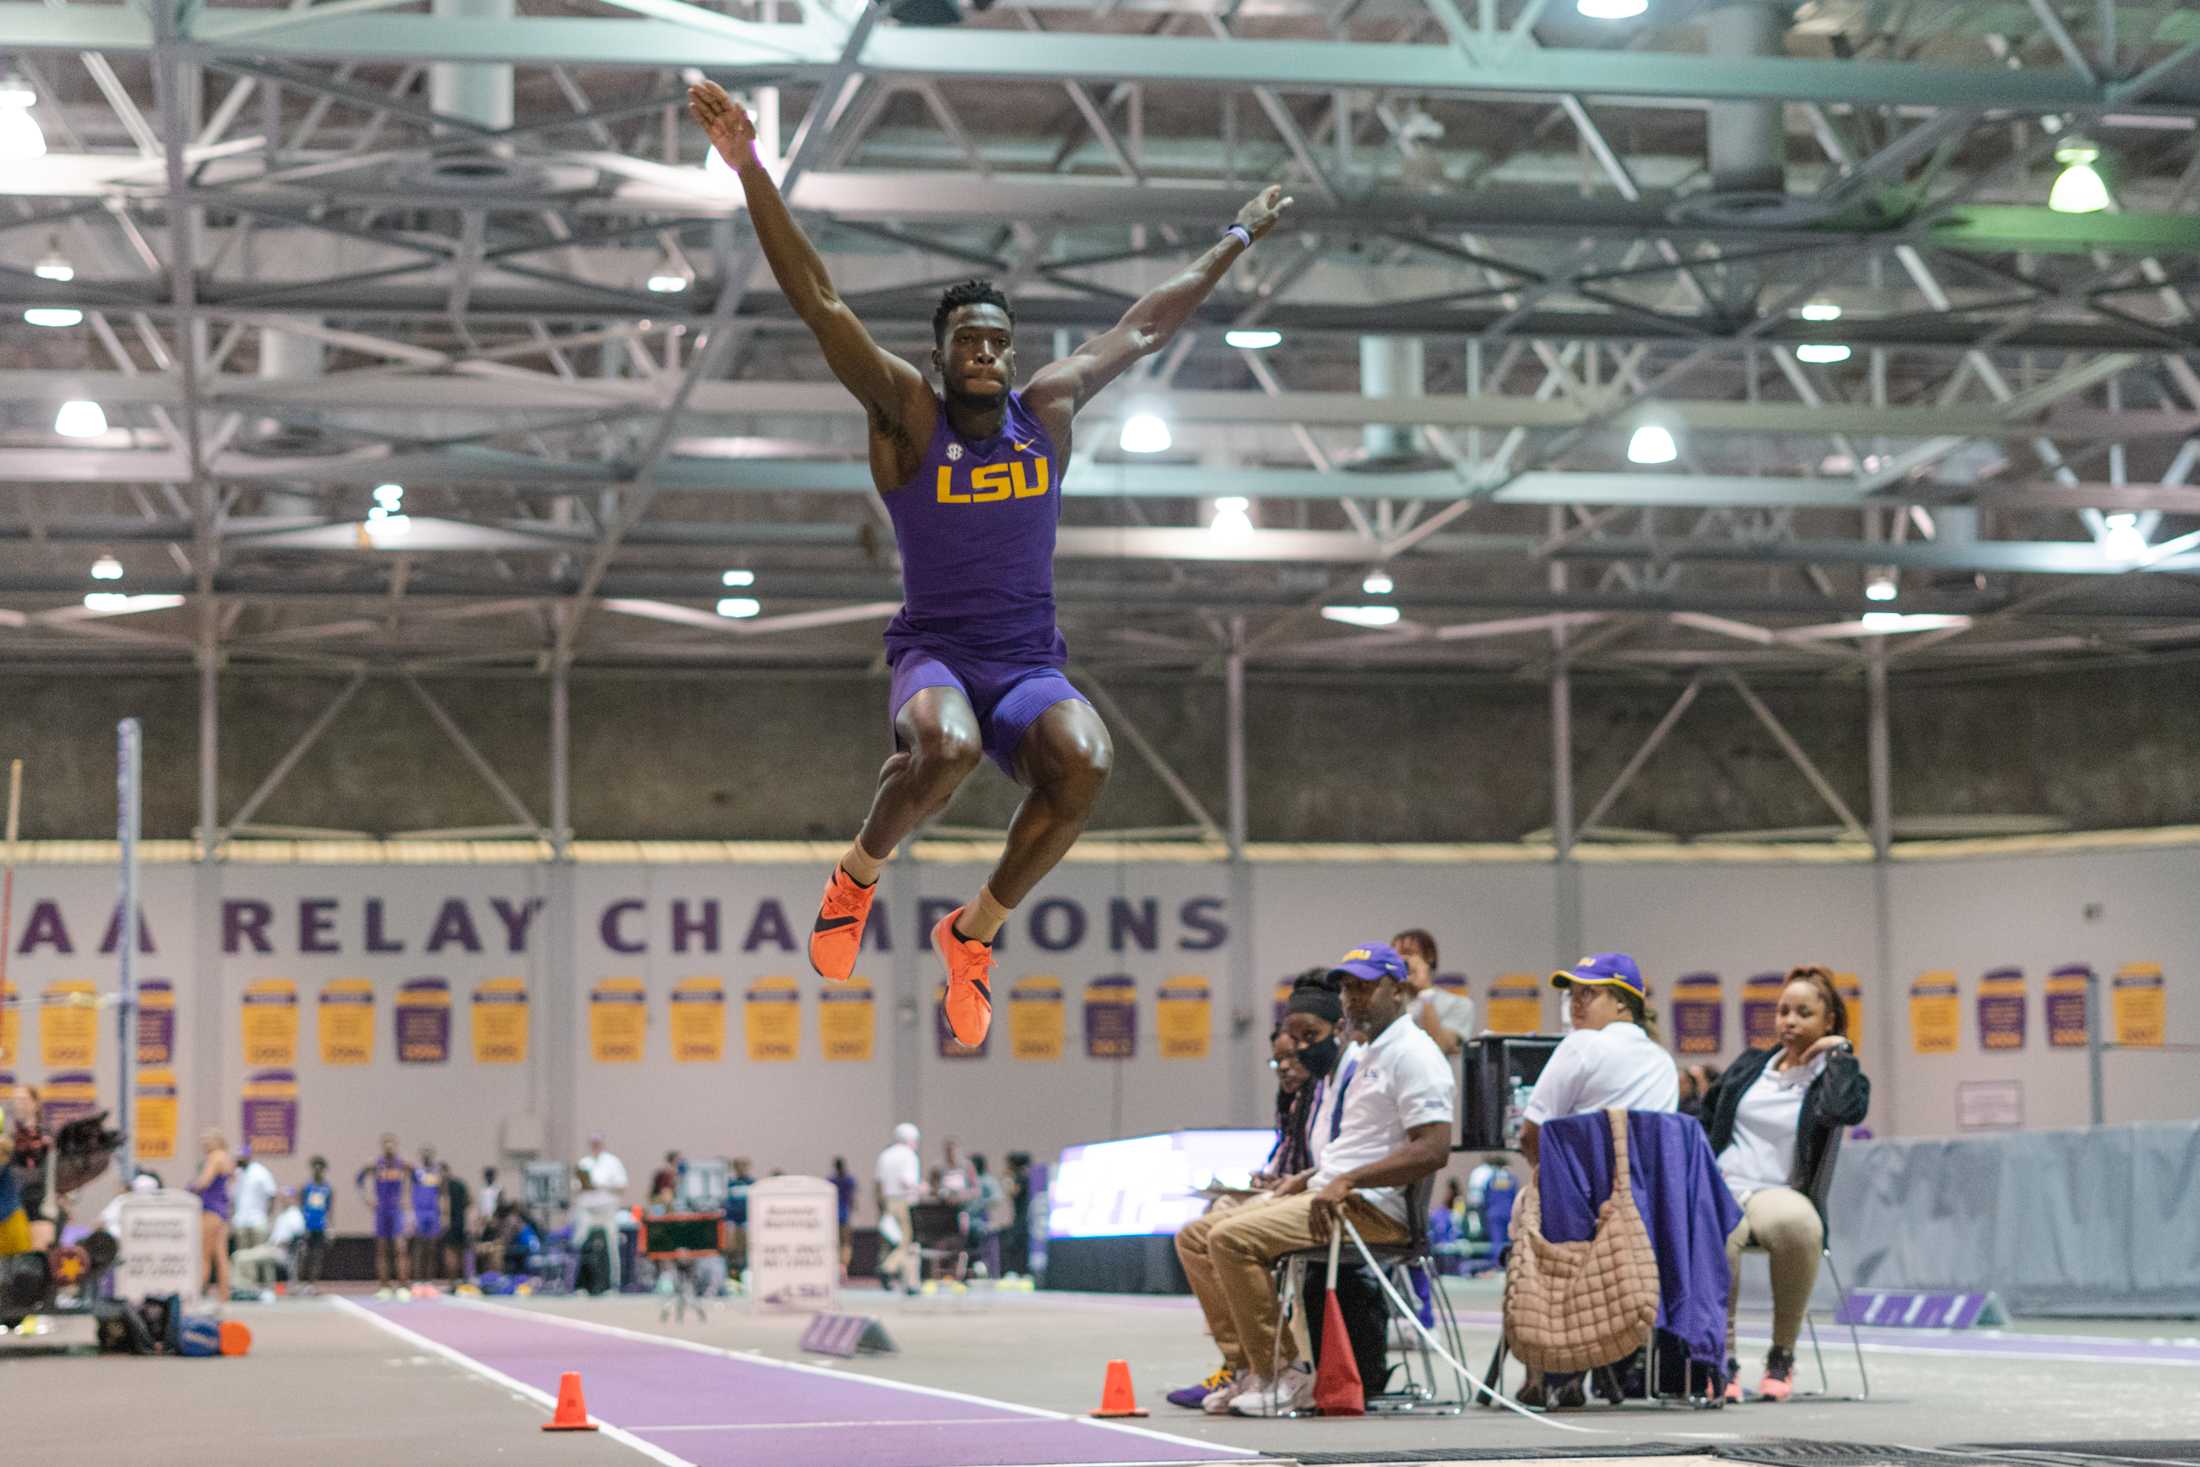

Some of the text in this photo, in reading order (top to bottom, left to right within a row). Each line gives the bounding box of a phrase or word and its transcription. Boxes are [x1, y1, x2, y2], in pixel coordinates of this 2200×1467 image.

[937, 456, 1049, 503] LSU
[222, 898, 544, 954] RELAY
[598, 896, 1230, 952] CHAPONS
